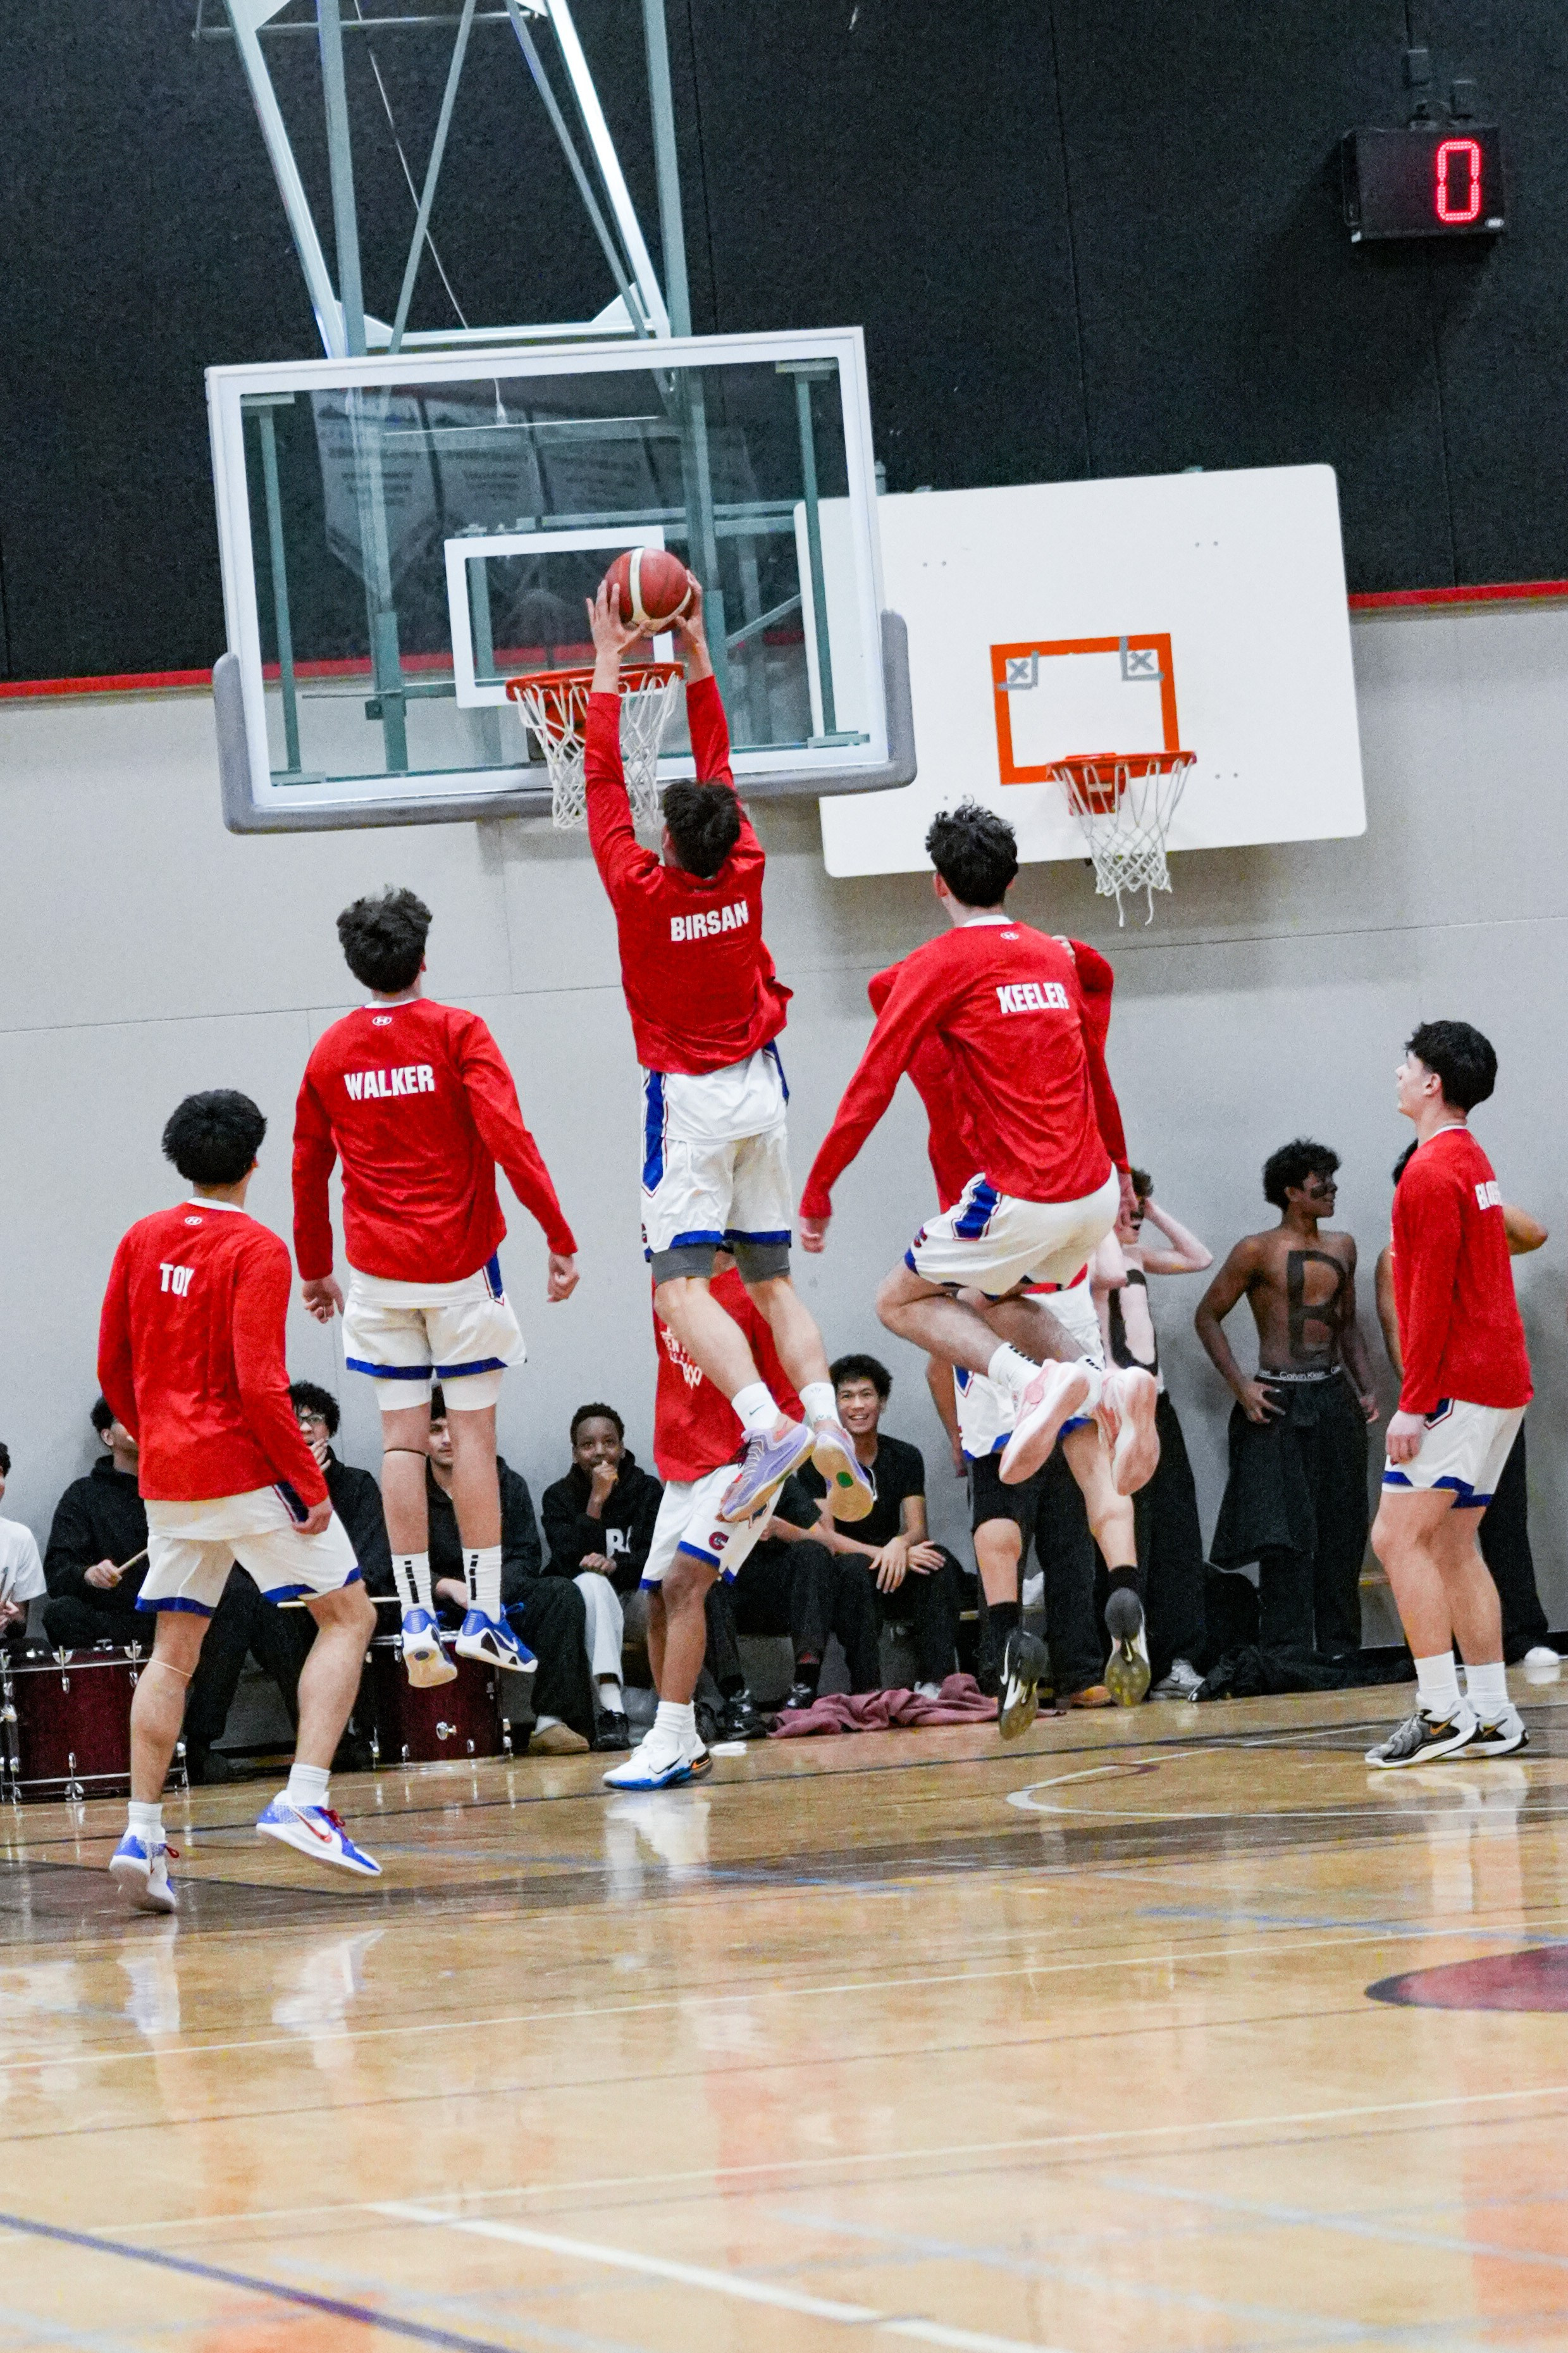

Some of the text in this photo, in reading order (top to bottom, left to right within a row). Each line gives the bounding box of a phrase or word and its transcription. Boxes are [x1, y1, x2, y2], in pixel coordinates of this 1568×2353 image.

[1436, 139, 1481, 222] 0
[670, 900, 749, 941] BIRSAN
[996, 982, 1070, 1014] KEELER
[343, 1064, 435, 1100] WALKER
[159, 1262, 195, 1297] TOY
